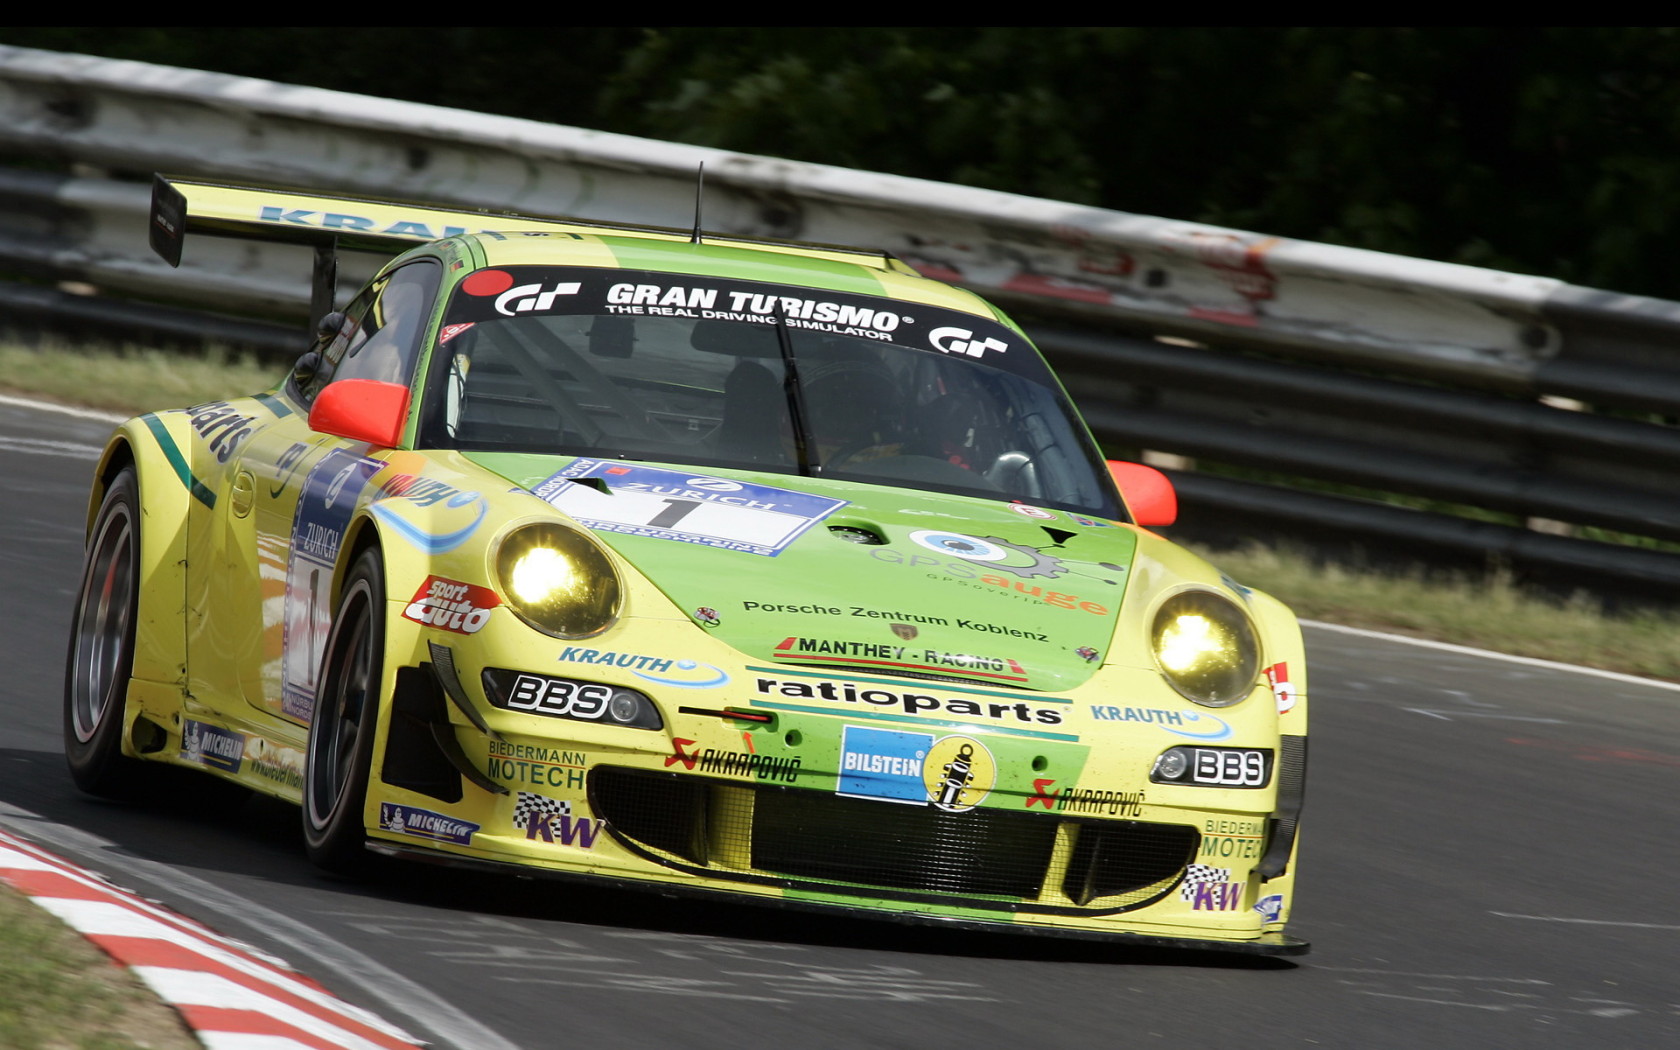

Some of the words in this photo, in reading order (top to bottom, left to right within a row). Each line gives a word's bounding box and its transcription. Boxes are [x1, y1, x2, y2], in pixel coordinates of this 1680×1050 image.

[606, 283, 719, 309] GRAN
[604, 304, 645, 315] THE
[649, 306, 699, 318] REAL
[702, 309, 777, 325] DRIVING
[785, 317, 893, 342] SIMULATOR
[625, 482, 776, 511] ZURICH
[645, 498, 703, 529] 1
[302, 523, 339, 559] ZURICH
[426, 580, 470, 601] sport
[307, 569, 319, 687] 1
[404, 596, 492, 634] auto
[743, 601, 842, 616] Porsche
[850, 606, 949, 626] Zentrum
[956, 618, 1050, 643] Koblenz
[558, 646, 674, 673] KRAUTH
[798, 637, 905, 660] MANTHEY
[924, 649, 1005, 673] RACING
[507, 673, 614, 720] BBS
[757, 678, 1063, 725] ratioparts
[1090, 705, 1183, 726] KRAUTH
[201, 730, 246, 761] MICHELIN
[488, 740, 587, 766] BIEDERMANN
[488, 757, 584, 791] MOTECH
[1193, 748, 1265, 787] BBS
[407, 813, 474, 837] MICHELIN
[525, 809, 602, 849] KW
[1192, 881, 1247, 911] KW
